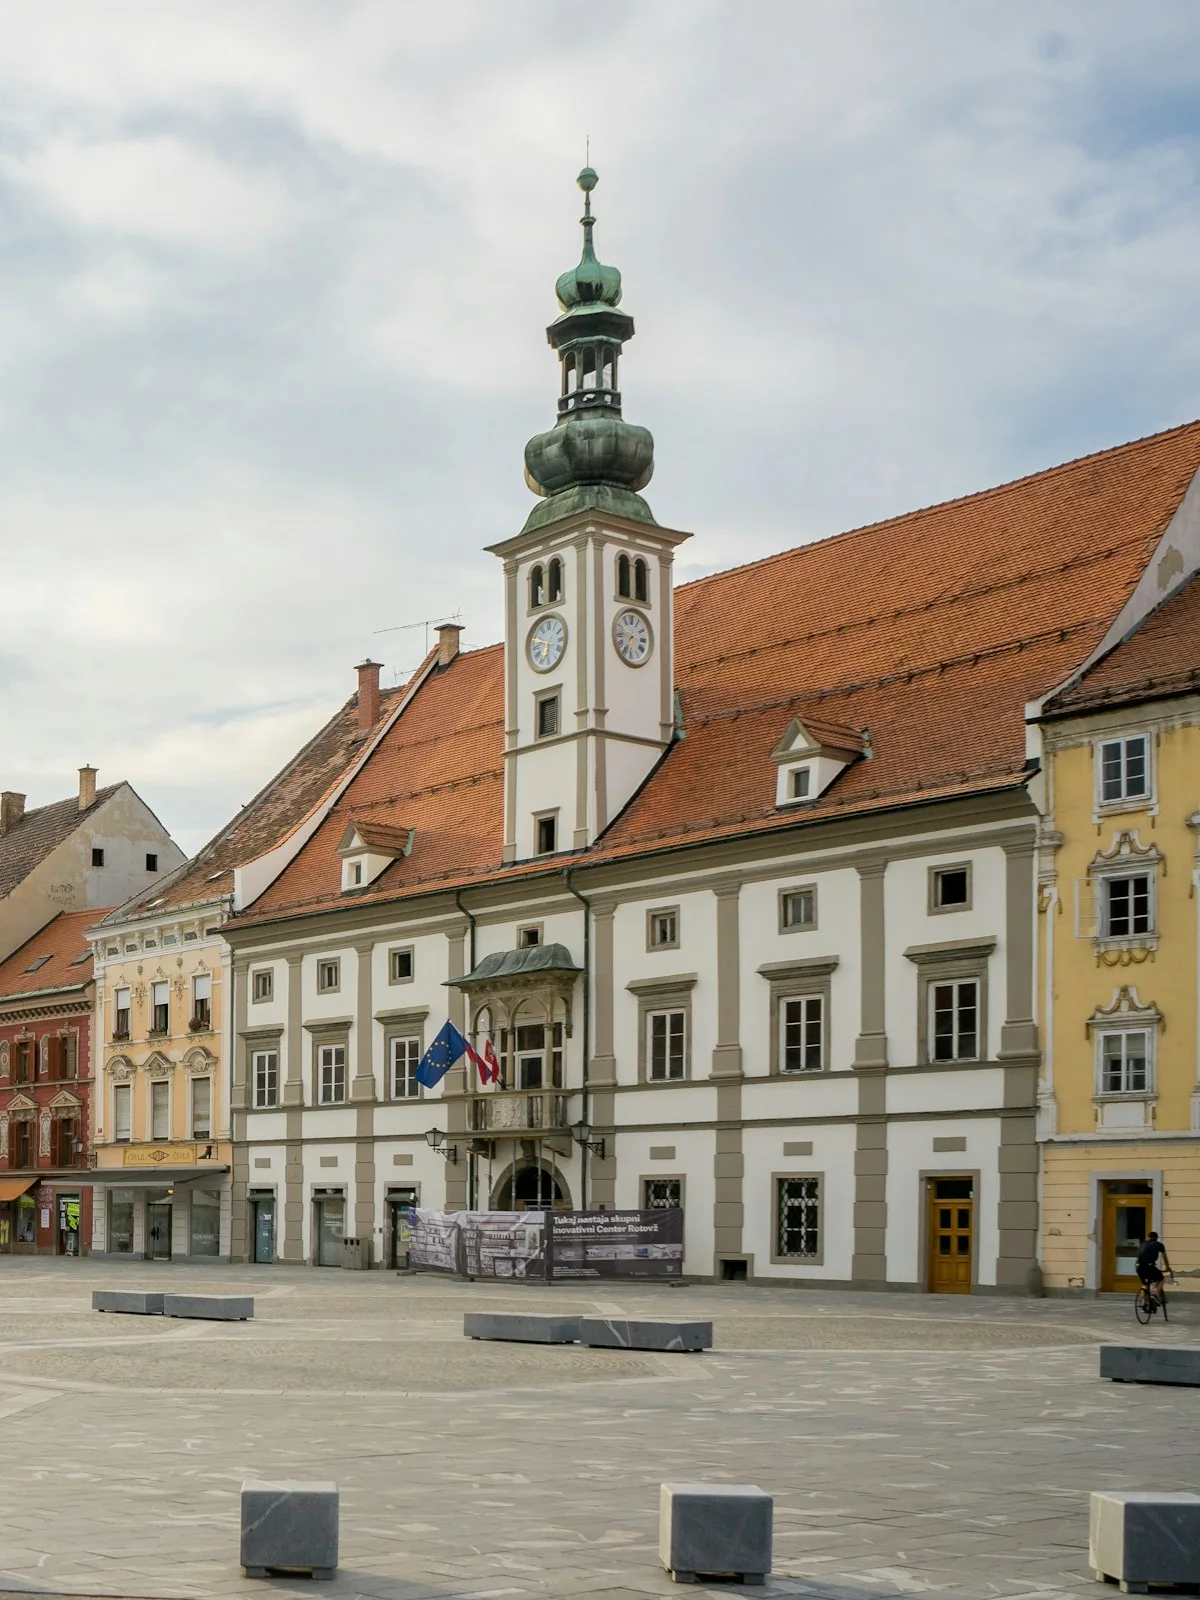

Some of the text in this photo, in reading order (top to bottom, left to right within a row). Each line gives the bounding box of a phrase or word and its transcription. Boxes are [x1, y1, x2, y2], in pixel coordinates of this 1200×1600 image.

[553, 1214, 640, 1225] Tukaj nastaja skupni
[552, 1224, 659, 1234] inovativni Center Rotovž
